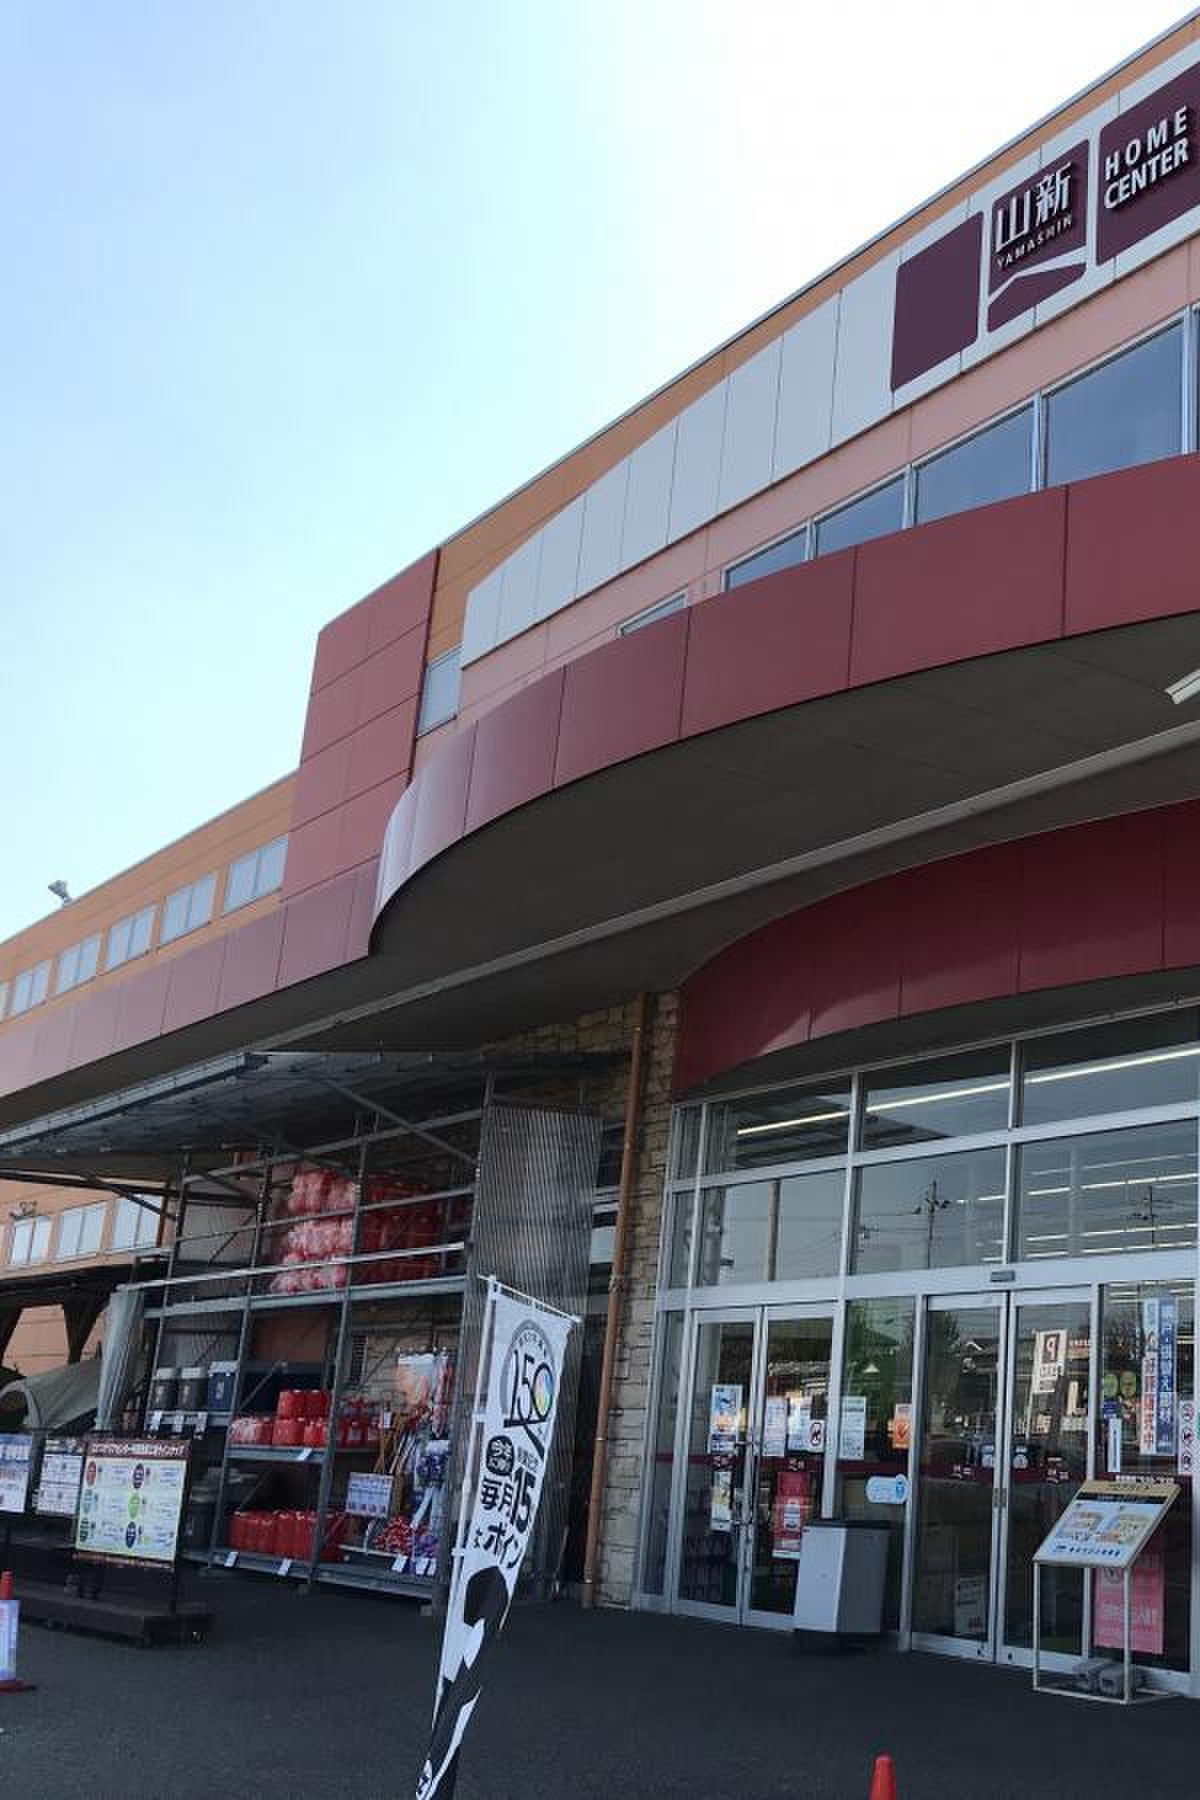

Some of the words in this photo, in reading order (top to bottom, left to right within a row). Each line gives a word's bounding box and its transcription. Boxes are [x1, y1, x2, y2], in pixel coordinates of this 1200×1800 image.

[1103, 138, 1189, 210] CENTER
[1105, 105, 1188, 180] HOME
[995, 161, 1072, 254] 山新
[997, 214, 1072, 268] YAMASHIN
